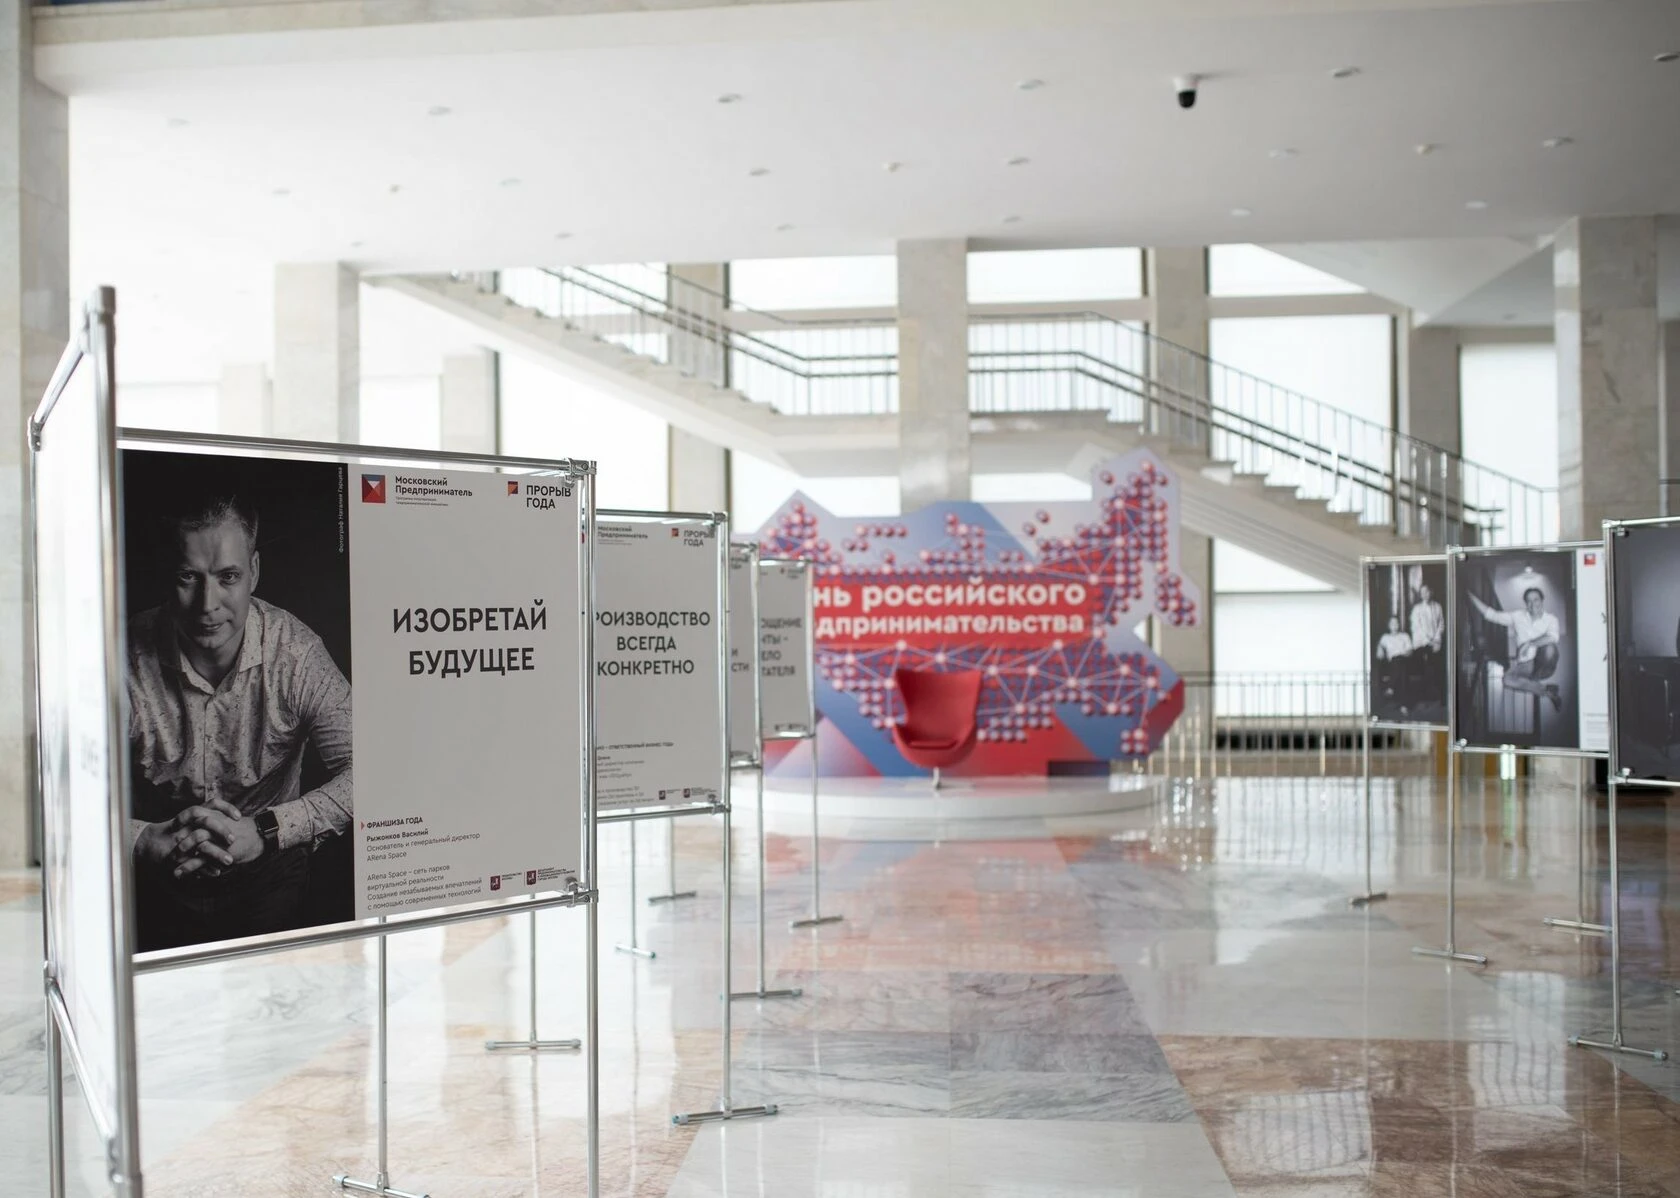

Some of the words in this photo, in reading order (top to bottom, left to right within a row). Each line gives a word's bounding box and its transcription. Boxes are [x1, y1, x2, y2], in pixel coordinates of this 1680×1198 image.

[395, 476, 448, 486] Московский
[395, 485, 473, 497] Предприниматель
[526, 484, 572, 497] ПРОРЫВ
[526, 497, 556, 510] ГОДА
[684, 538, 704, 547] ГОДА
[861, 576, 1086, 613] российского
[393, 598, 547, 633] ИЗОБРЕТАЙ
[815, 613, 1085, 639] дпринимательства
[617, 635, 677, 653] ВСЕГДА
[409, 647, 535, 679] БУДУЩЕЕ
[597, 659, 695, 676] КОНКРЕТНО
[366, 818, 405, 829] ФРАНШИЗА
[405, 816, 423, 825] ГОДА
[401, 828, 429, 838] Василий
[366, 842, 404, 852] Основатель
[410, 835, 451, 847] генеральный
[451, 832, 481, 844] директор
[387, 851, 407, 861] Space
[387, 870, 407, 880] Space
[413, 867, 428, 875] сеть
[428, 864, 450, 874] парков
[367, 879, 407, 892] виртуальной
[408, 874, 444, 887] реальности
[367, 891, 398, 901] Создание
[399, 885, 444, 897] незабываемых
[404, 894, 446, 905] современных
[448, 886, 482, 899] технологий
